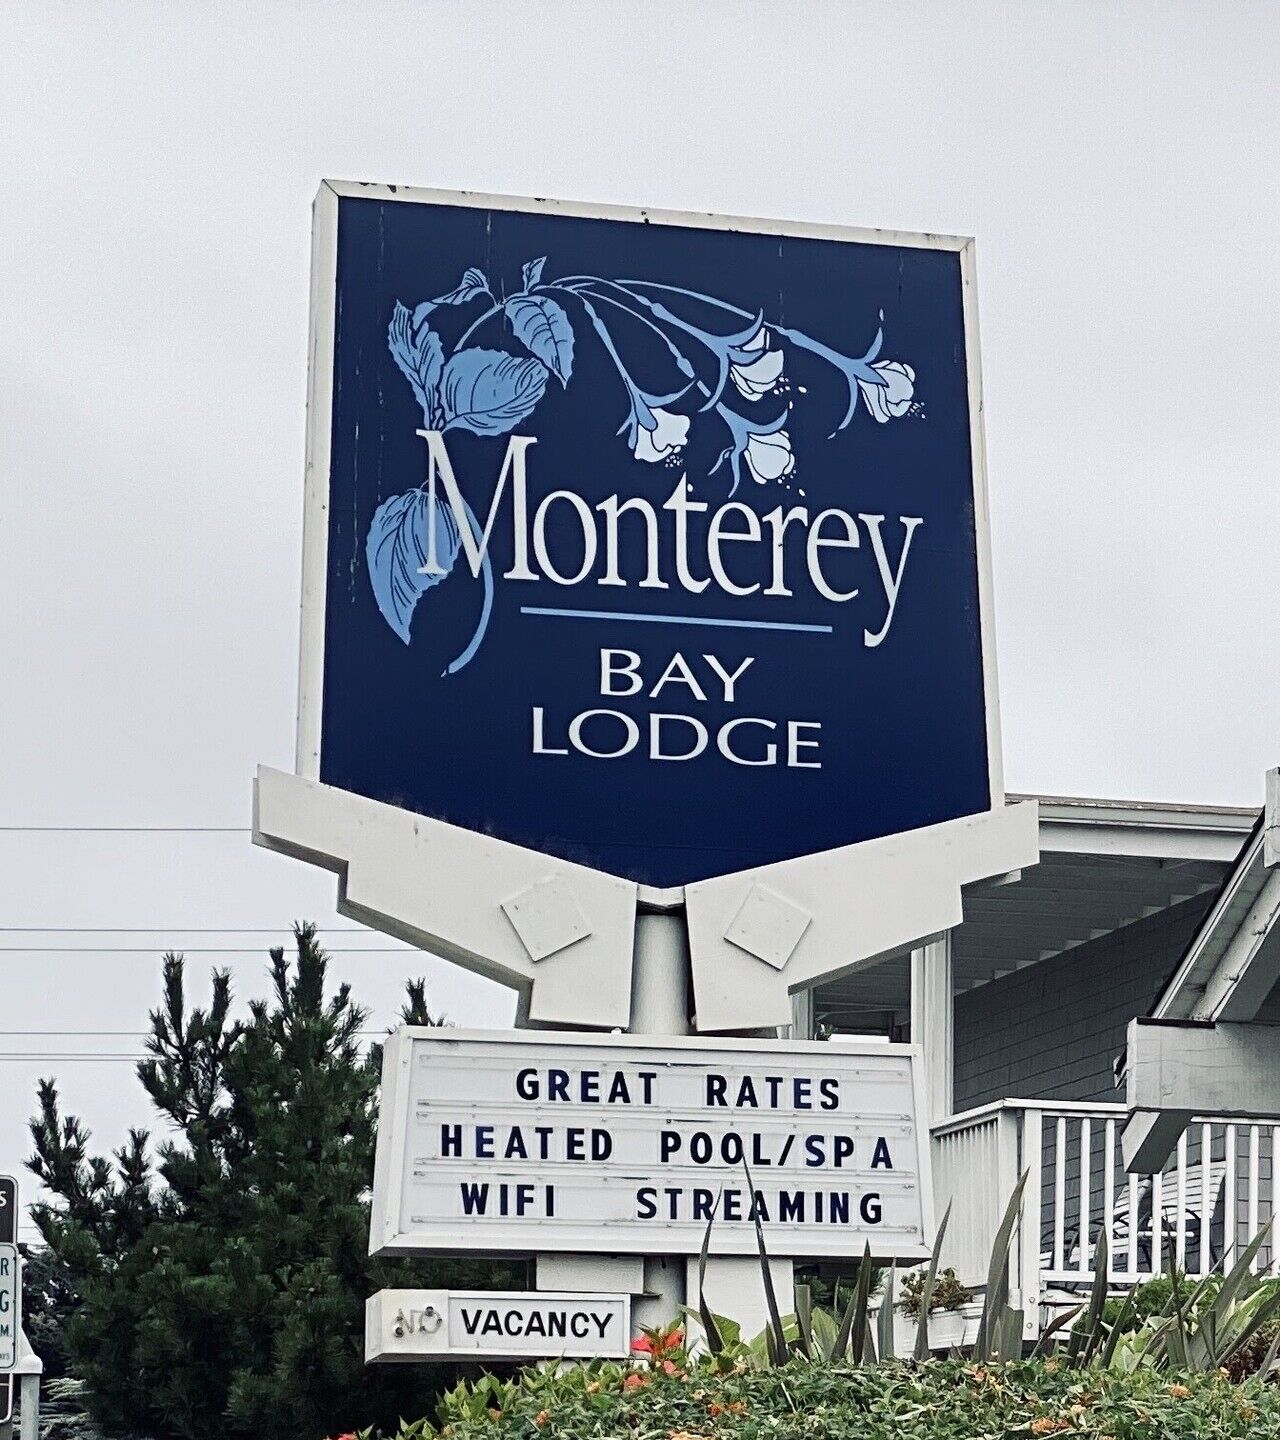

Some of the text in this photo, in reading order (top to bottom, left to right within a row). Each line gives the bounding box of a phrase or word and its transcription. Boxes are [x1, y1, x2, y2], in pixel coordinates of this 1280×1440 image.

[415, 429, 922, 647] Monterey
[600, 648, 755, 702] BAY
[531, 706, 822, 768] LODGE
[516, 1068, 840, 1110] GREAT RATES
[441, 1124, 613, 1162] HEATED
[461, 1182, 882, 1225] WIFI STREAMING
[461, 1309, 614, 1339] VACANCY
